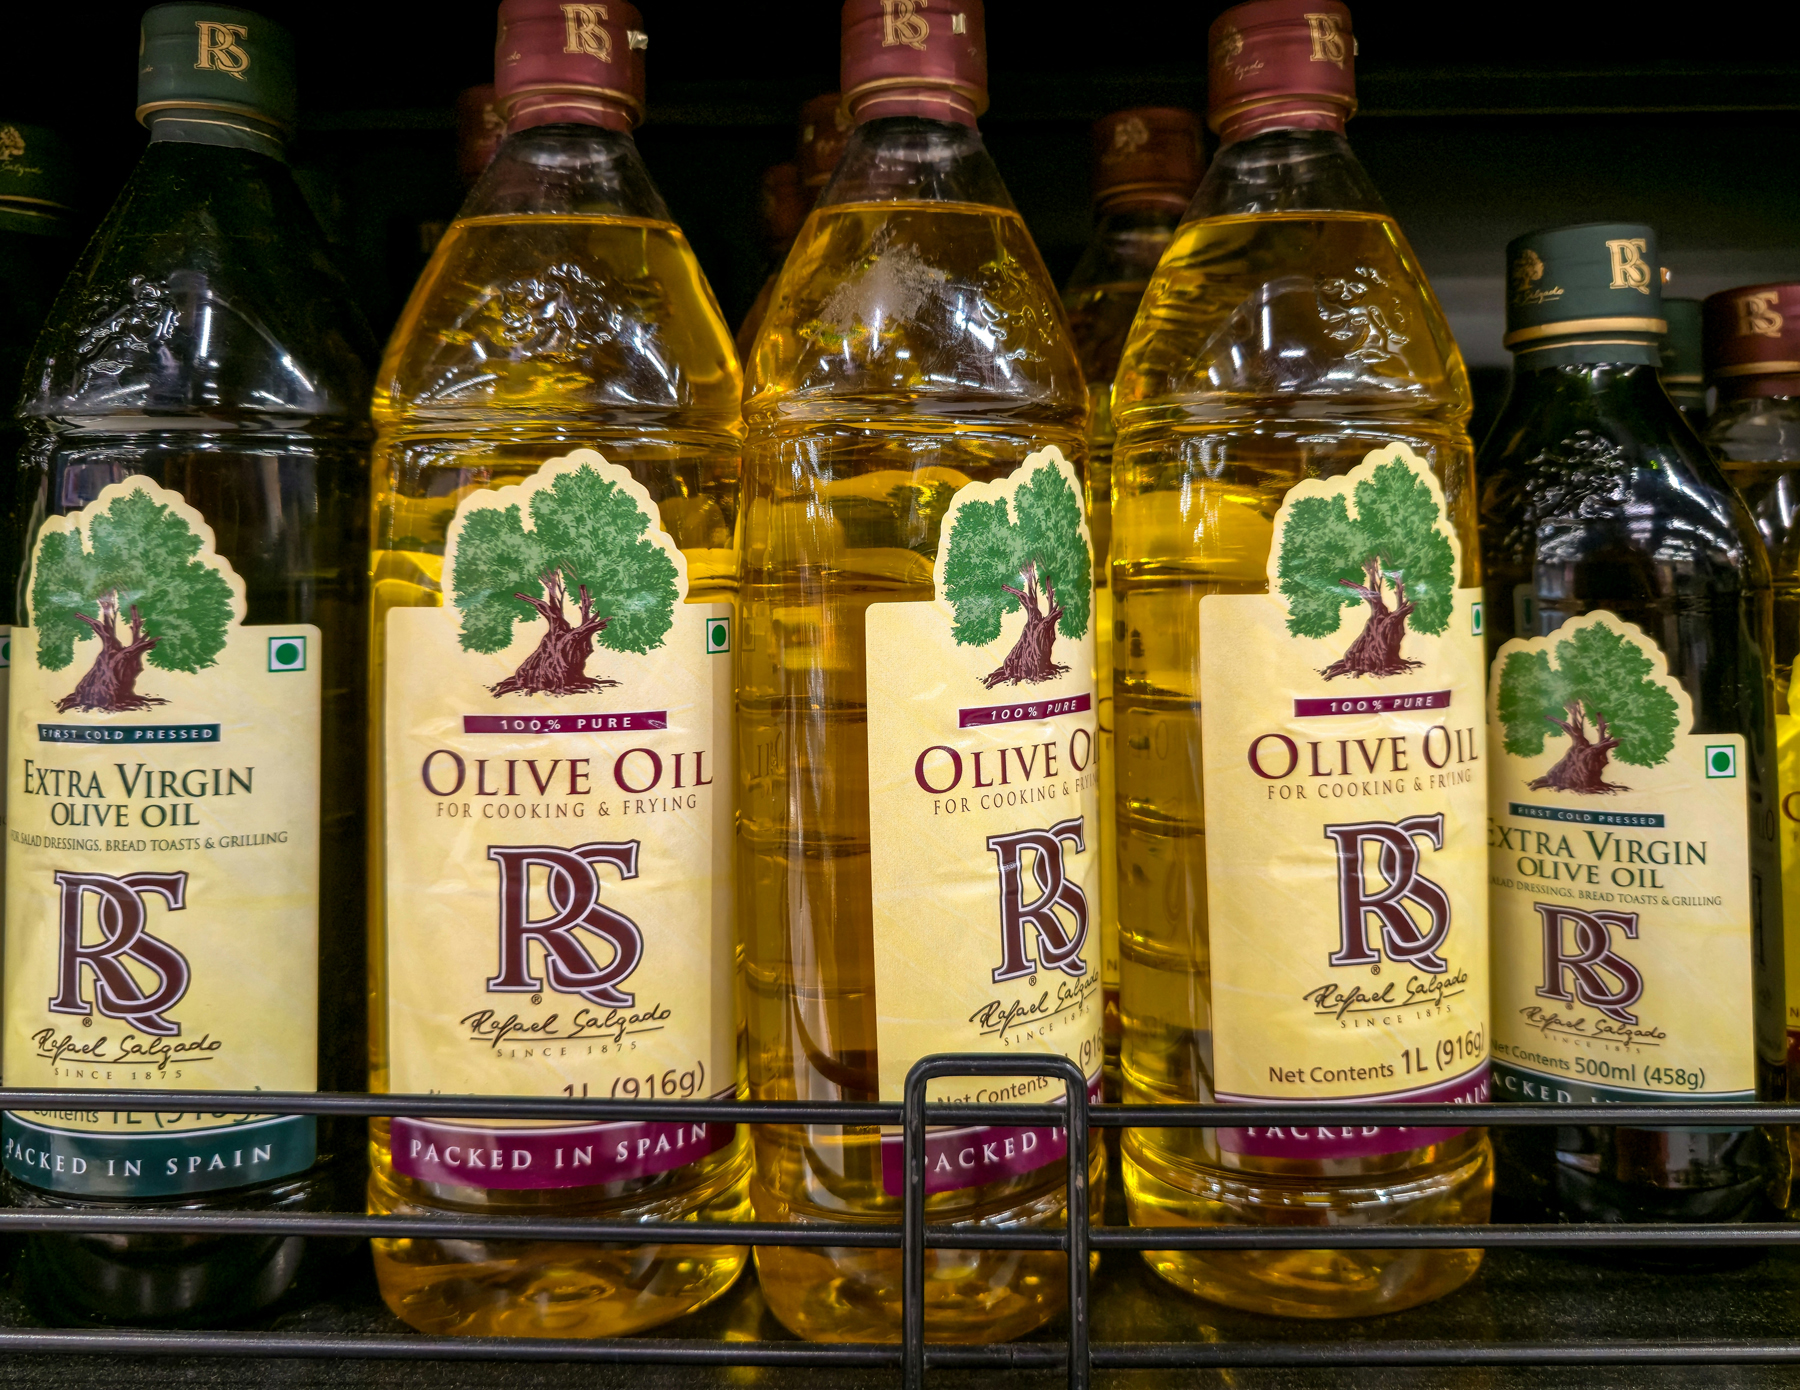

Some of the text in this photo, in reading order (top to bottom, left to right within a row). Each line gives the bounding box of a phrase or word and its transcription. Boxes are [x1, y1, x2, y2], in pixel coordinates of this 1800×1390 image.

[560, 3, 613, 64] RS
[881, 0, 930, 51] RS
[1304, 13, 1345, 70] RS
[193, 20, 250, 82] RS
[1605, 238, 1651, 295] RS
[1736, 291, 1783, 338] RS
[500, 716, 633, 732] 100% PURE
[991, 699, 1077, 721] 100% PURE
[1330, 696, 1433, 712] 100% PURE
[42, 728, 213, 740] FIRST COLD PRESSED
[1247, 725, 1479, 779] OLIVE OIL
[24, 759, 255, 799] EXTRA VIRGIN
[422, 747, 714, 797] OLIVE OIL
[914, 741, 1058, 794] OLIVE
[437, 793, 698, 819] FOR COOKING & FRYING
[934, 797, 970, 815] FOR
[981, 783, 1055, 810] COOKING
[1062, 781, 1070, 795] &
[1268, 784, 1307, 800] FOR
[1318, 778, 1405, 799] COOKING
[1413, 777, 1422, 791] &
[51, 802, 200, 827] OLIVE OIL
[1518, 806, 1656, 825] FIRST COLD PRESSED
[106, 839, 147, 852] BREAD
[149, 838, 200, 851] TOASTS
[204, 837, 215, 849] &
[219, 831, 288, 849] GRILLING
[1583, 830, 1707, 865] VIRGIN
[1323, 812, 1451, 974] RS
[1517, 856, 1664, 889] OLIVE OIL
[986, 815, 1090, 984] RS
[1578, 890, 1615, 902] BREAD
[1617, 894, 1658, 905] TOASTS
[1661, 896, 1670, 905] &
[1672, 896, 1722, 906] GRILLING
[486, 839, 644, 1008] RS
[48, 869, 191, 1037] RS
[1533, 901, 1644, 1026] RS
[969, 967, 1099, 1038] Rafael Salgado
[1302, 968, 1468, 1020] Rafael Salgado
[460, 1003, 672, 1048] Rafael Salgado
[1004, 1022, 1054, 1046] SINCE
[1064, 1005, 1091, 1025] 1875
[1340, 1004, 1452, 1028] SINCE 1875
[1519, 1006, 1667, 1047] Rafael Salgado
[32, 1027, 222, 1070] Rafael Salgado
[497, 1041, 638, 1058] SINCE 1875
[1269, 1022, 1484, 1083] Net Contents 1L (916g)
[1512, 1046, 1570, 1070] Contents
[1574, 1057, 1636, 1082] 500ml
[1643, 1065, 1706, 1090] (458g)
[54, 1067, 182, 1080] SINCE 1875
[1493, 1072, 1572, 1103] ACKED
[5, 1138, 272, 1176] PACKED IN SPAIN
[410, 1121, 708, 1169] PACKED IN SPAIN
[925, 1131, 1037, 1172] ACKED
